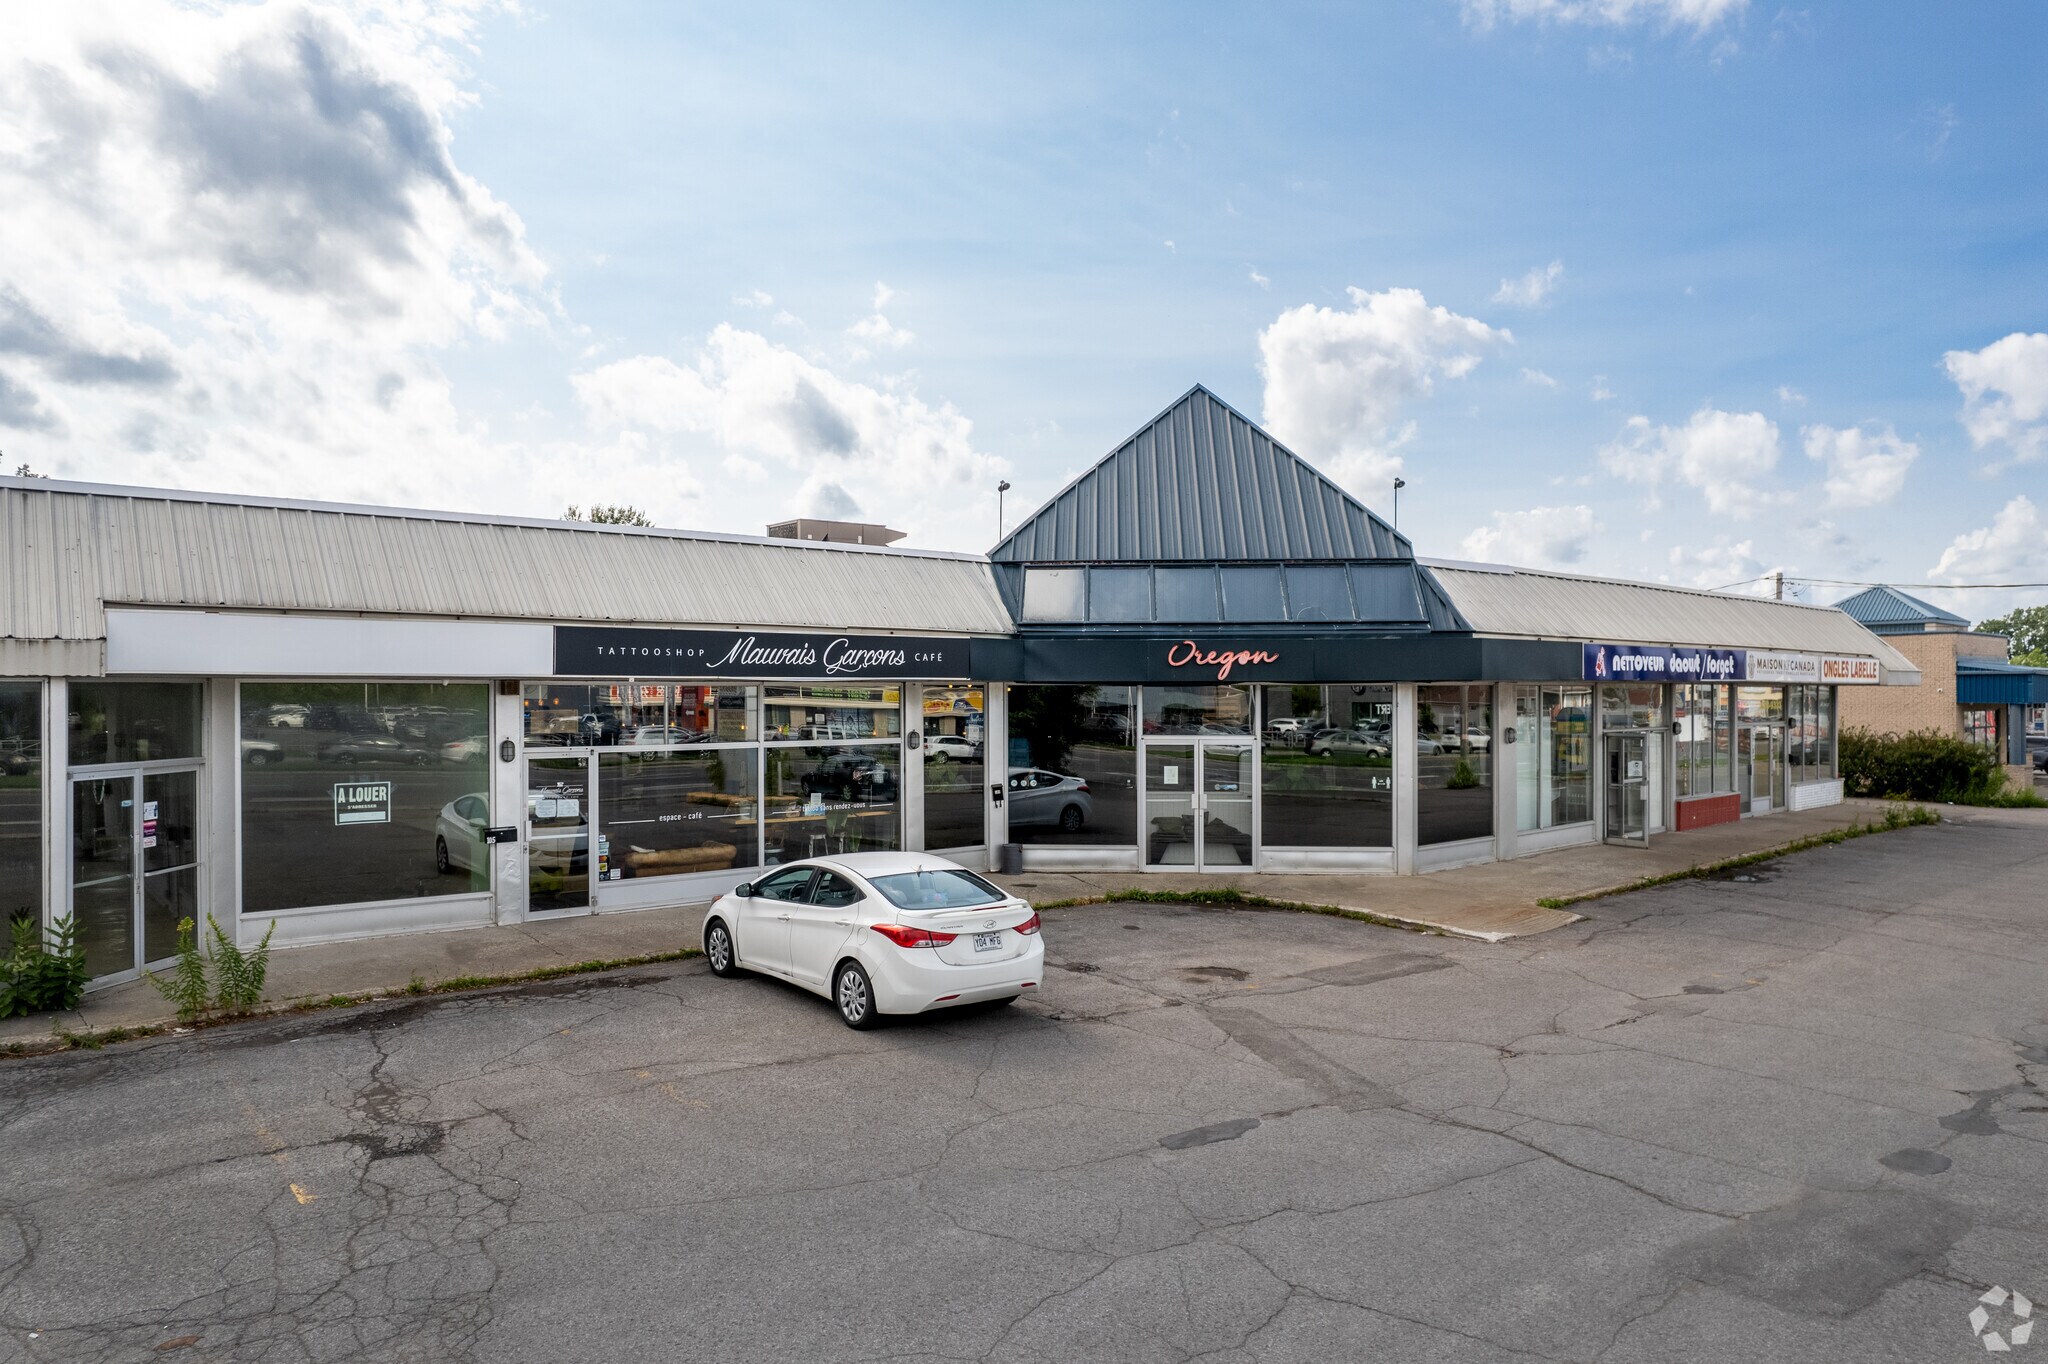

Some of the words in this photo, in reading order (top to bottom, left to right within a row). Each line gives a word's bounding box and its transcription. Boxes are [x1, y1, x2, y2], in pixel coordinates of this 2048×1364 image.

[597, 646, 705, 657] TATTOOSHOP
[706, 636, 817, 668] Mauvais
[823, 638, 906, 675] Garçons
[914, 652, 943, 662] CAFÉ
[1167, 640, 1280, 681] Oregon
[1612, 654, 1665, 672] NETTOYEUR
[1756, 658, 1783, 670] MAISON
[1790, 660, 1816, 672] CANADA
[1823, 660, 1850, 678] ONGLES
[1850, 661, 1877, 678] LABELLE
[337, 787, 346, 804] A
[348, 786, 387, 803] LOUER
[659, 814, 682, 823] espace
[688, 811, 703, 820] café
